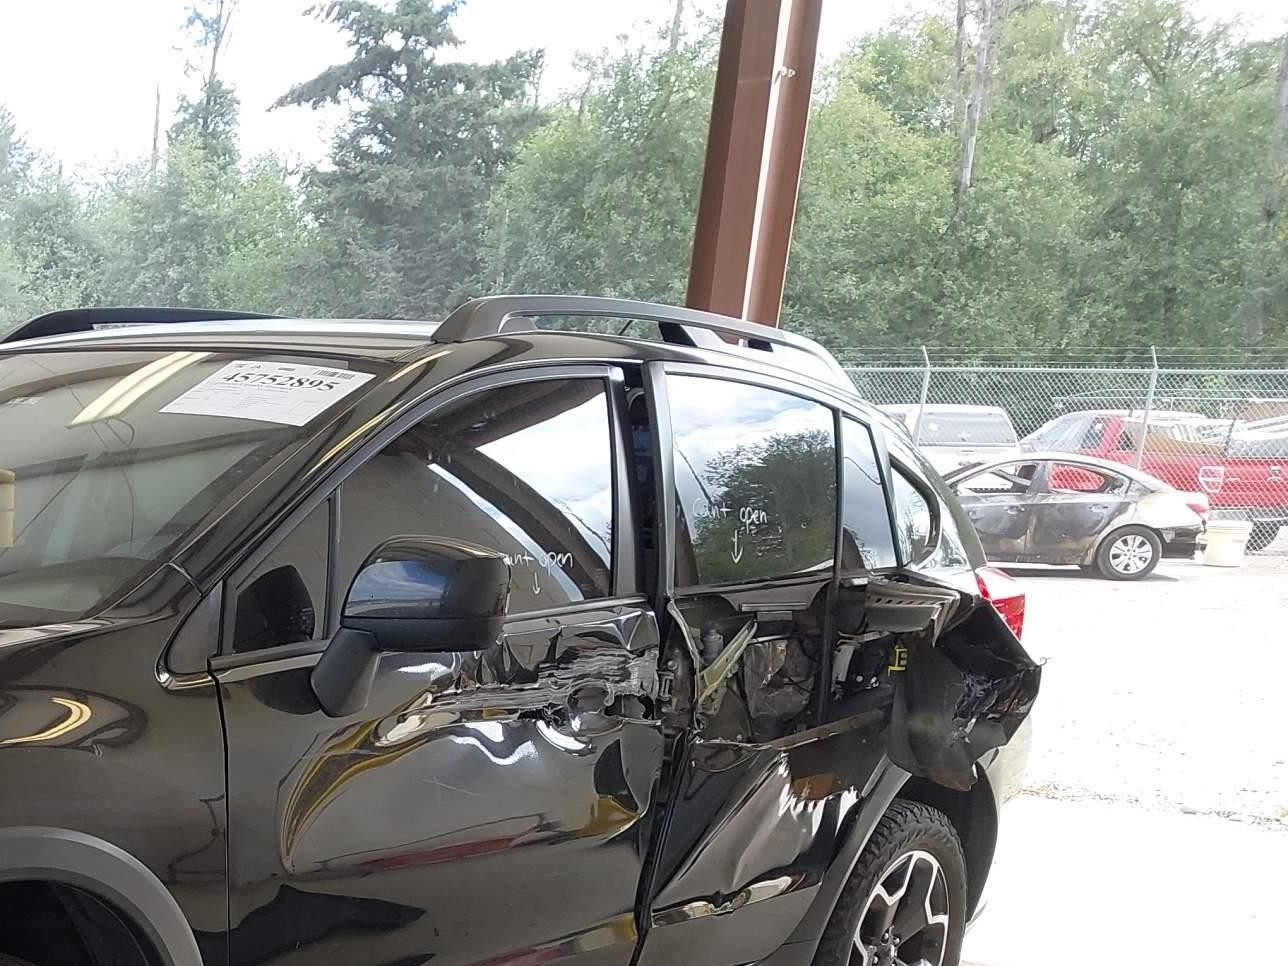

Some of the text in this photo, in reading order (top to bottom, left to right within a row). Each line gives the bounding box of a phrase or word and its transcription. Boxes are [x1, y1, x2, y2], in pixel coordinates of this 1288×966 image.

[222, 371, 342, 392] 45752895
[739, 506, 768, 534] open
[503, 551, 573, 577] ant open
